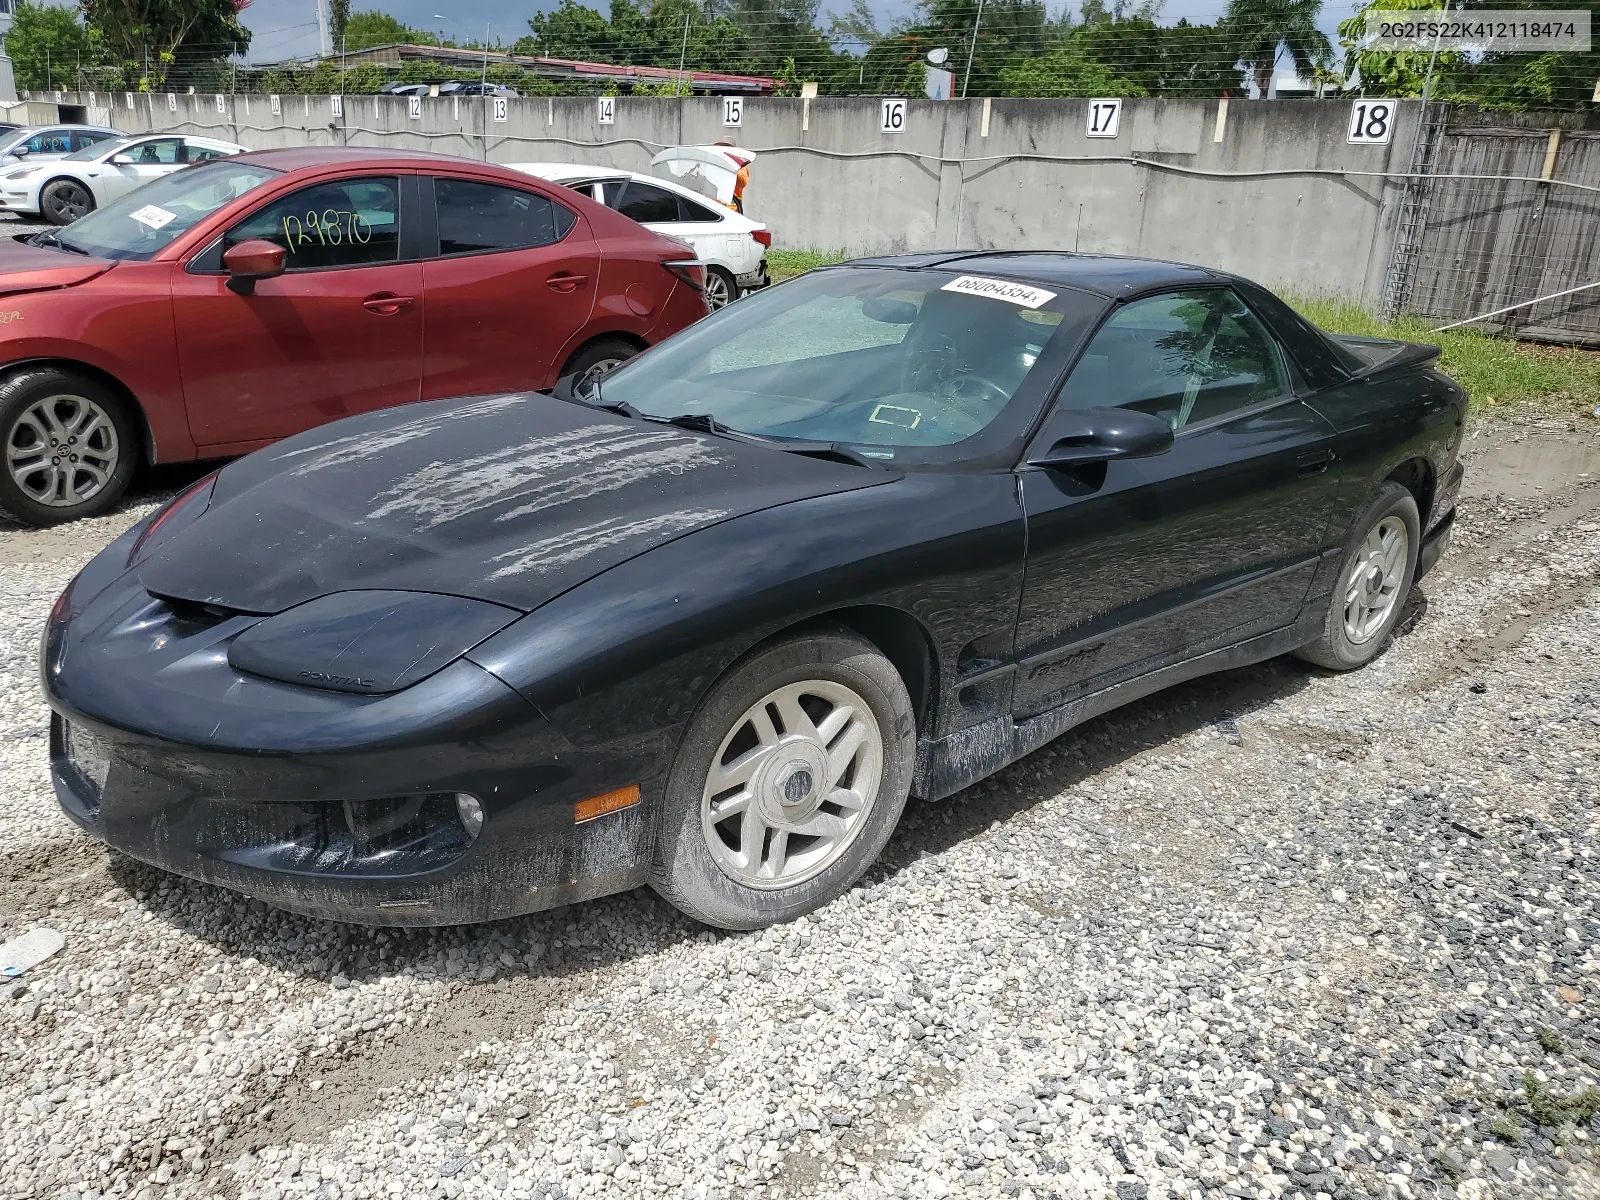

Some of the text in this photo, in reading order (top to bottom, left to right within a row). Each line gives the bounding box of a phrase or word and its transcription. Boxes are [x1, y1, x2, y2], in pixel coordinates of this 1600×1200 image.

[218, 97, 223, 111] 9
[271, 97, 280, 113] 10
[332, 98, 341, 114] 11
[411, 99, 420, 116] 12
[495, 101, 506, 119] 13
[600, 101, 613, 121] 14
[726, 100, 740, 123] 15
[884, 103, 903, 128] 16
[1091, 104, 1117, 132] 17
[1353, 105, 1389, 138] 18
[283, 209, 372, 254] 129870
[297, 669, 375, 687] PONTIAC
